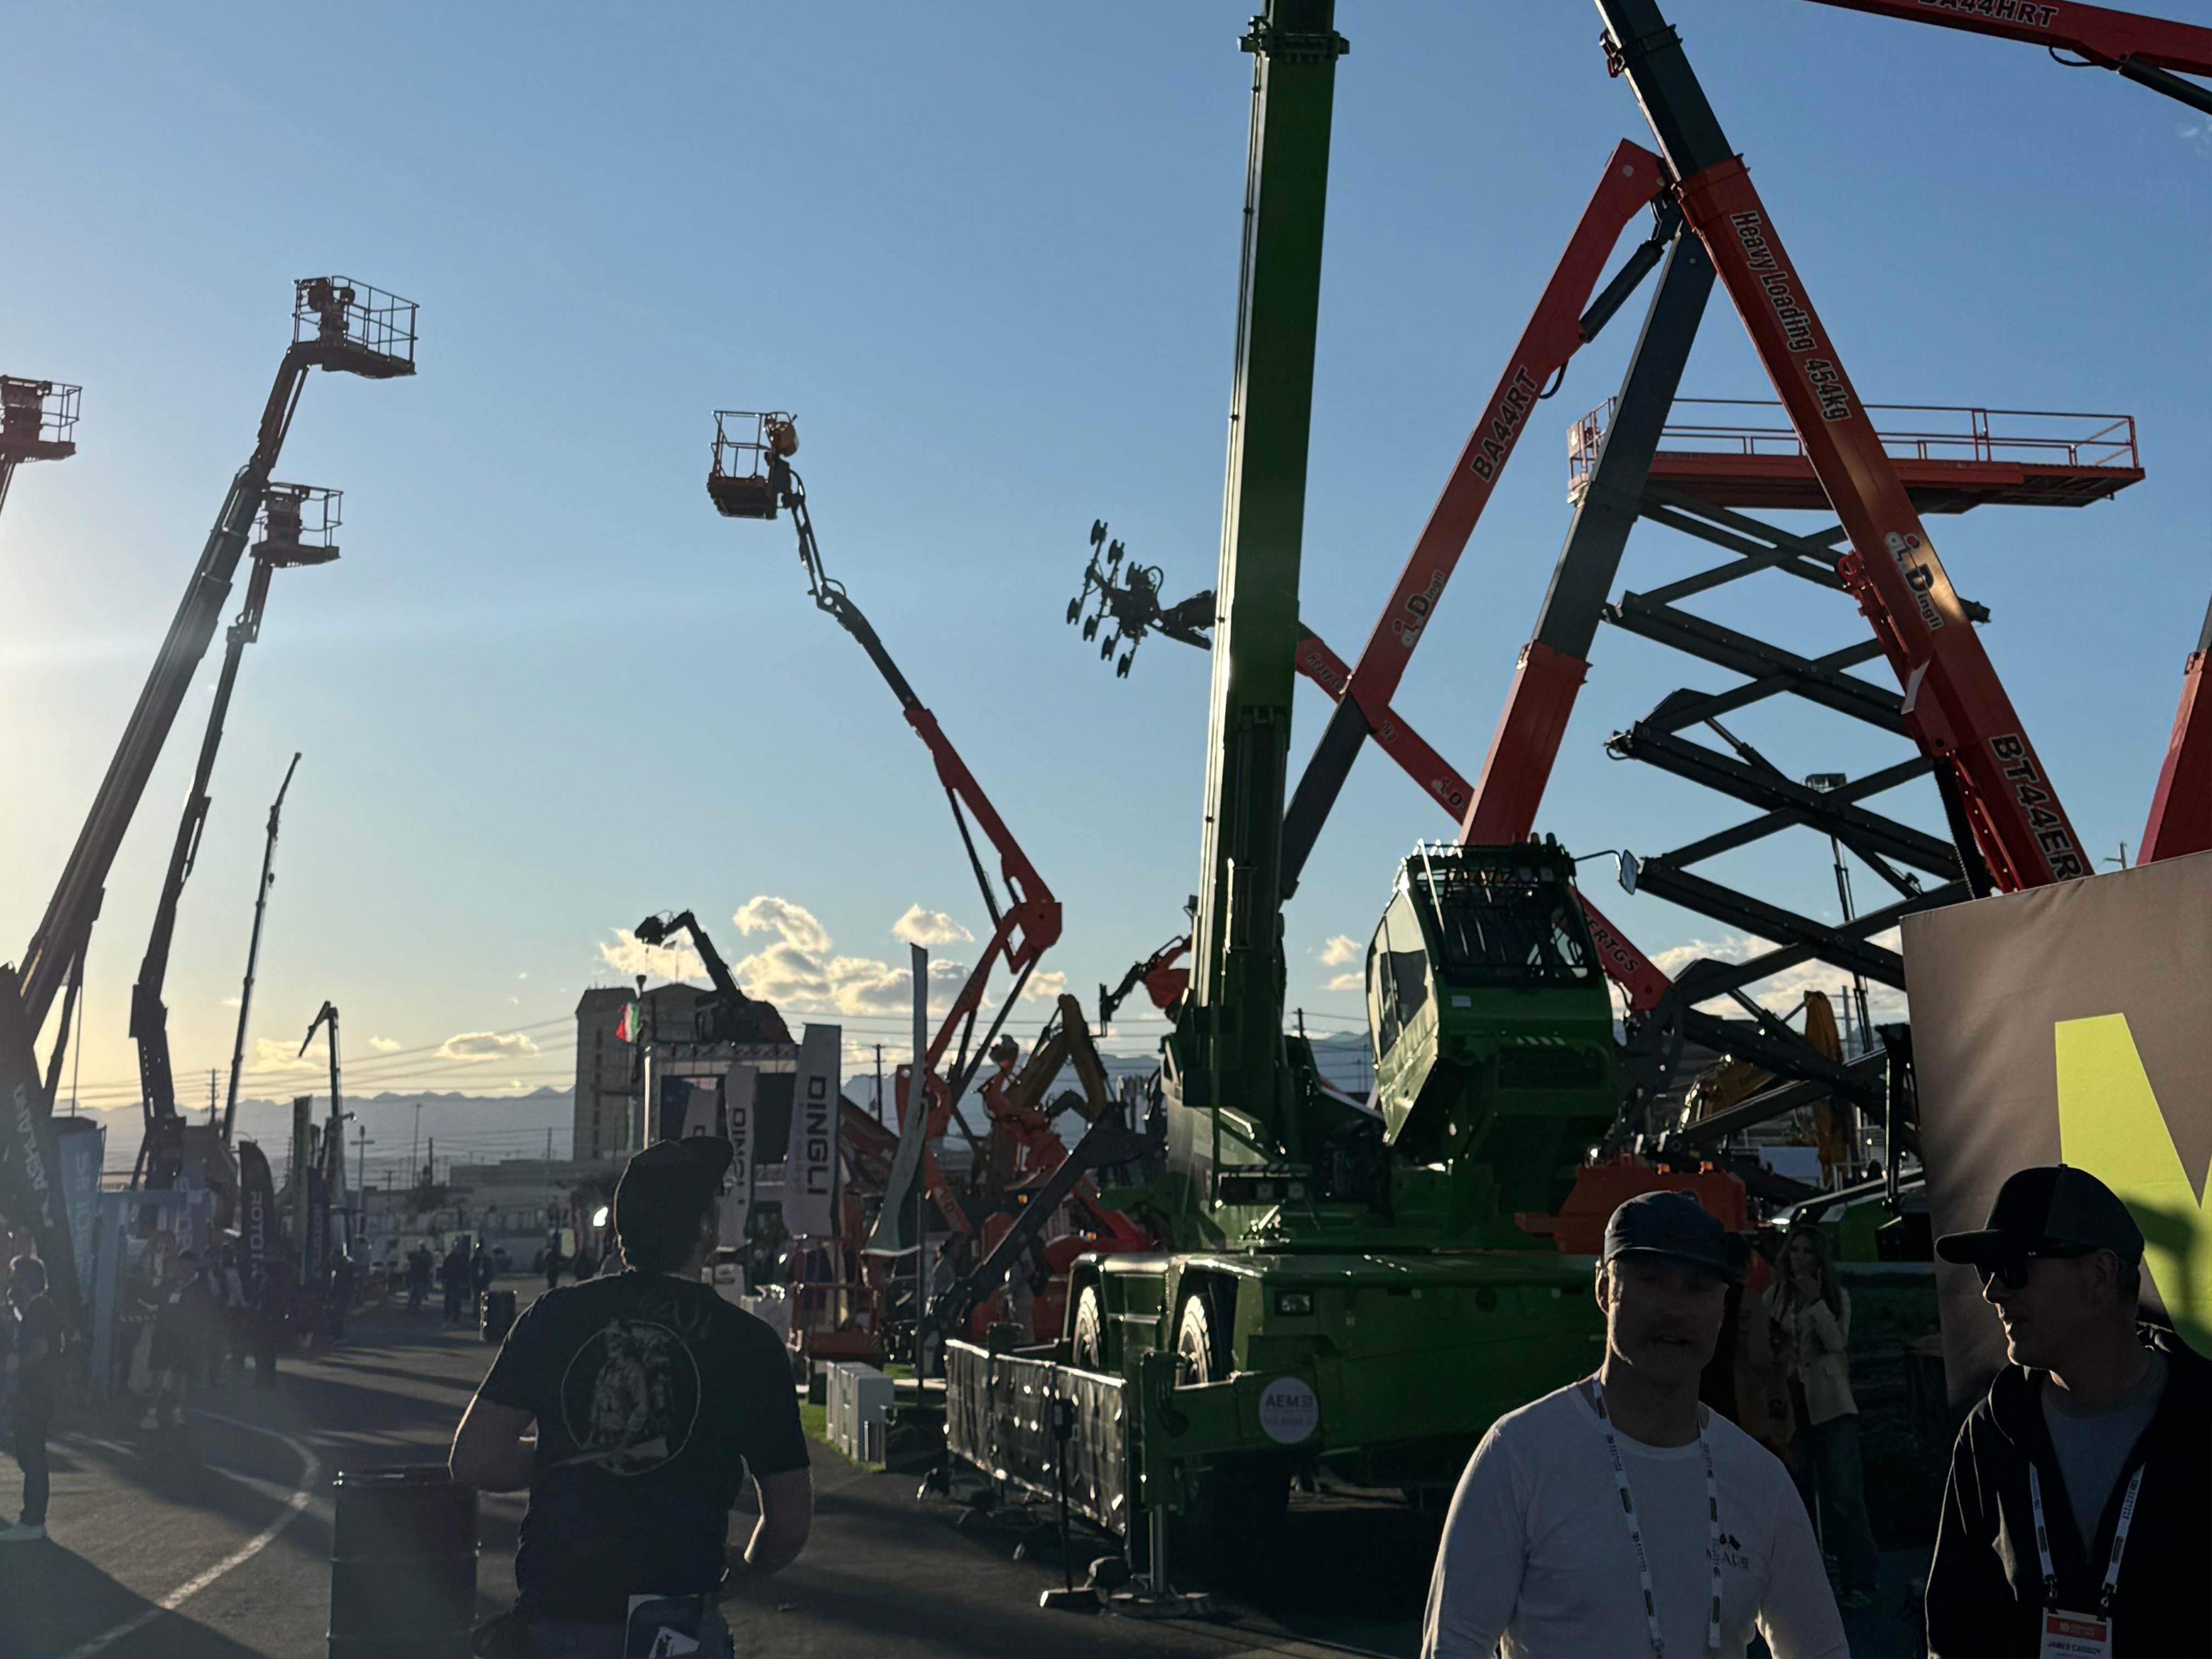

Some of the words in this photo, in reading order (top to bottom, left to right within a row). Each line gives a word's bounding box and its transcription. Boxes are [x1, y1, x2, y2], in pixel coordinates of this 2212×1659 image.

[1730, 210, 1778, 271] Heavy
[1759, 270, 1818, 353] Loading
[1804, 358, 1852, 423] 454kg
[1470, 364, 1538, 484] BA44RT
[1406, 569, 1447, 618] Dingli
[1905, 563, 1945, 630] Dingli
[1988, 732, 2084, 882] BT44ER
[1584, 913, 1639, 972] ERTGS
[806, 1075, 828, 1195] DINGLI
[1266, 1394, 1300, 1408] AEM
